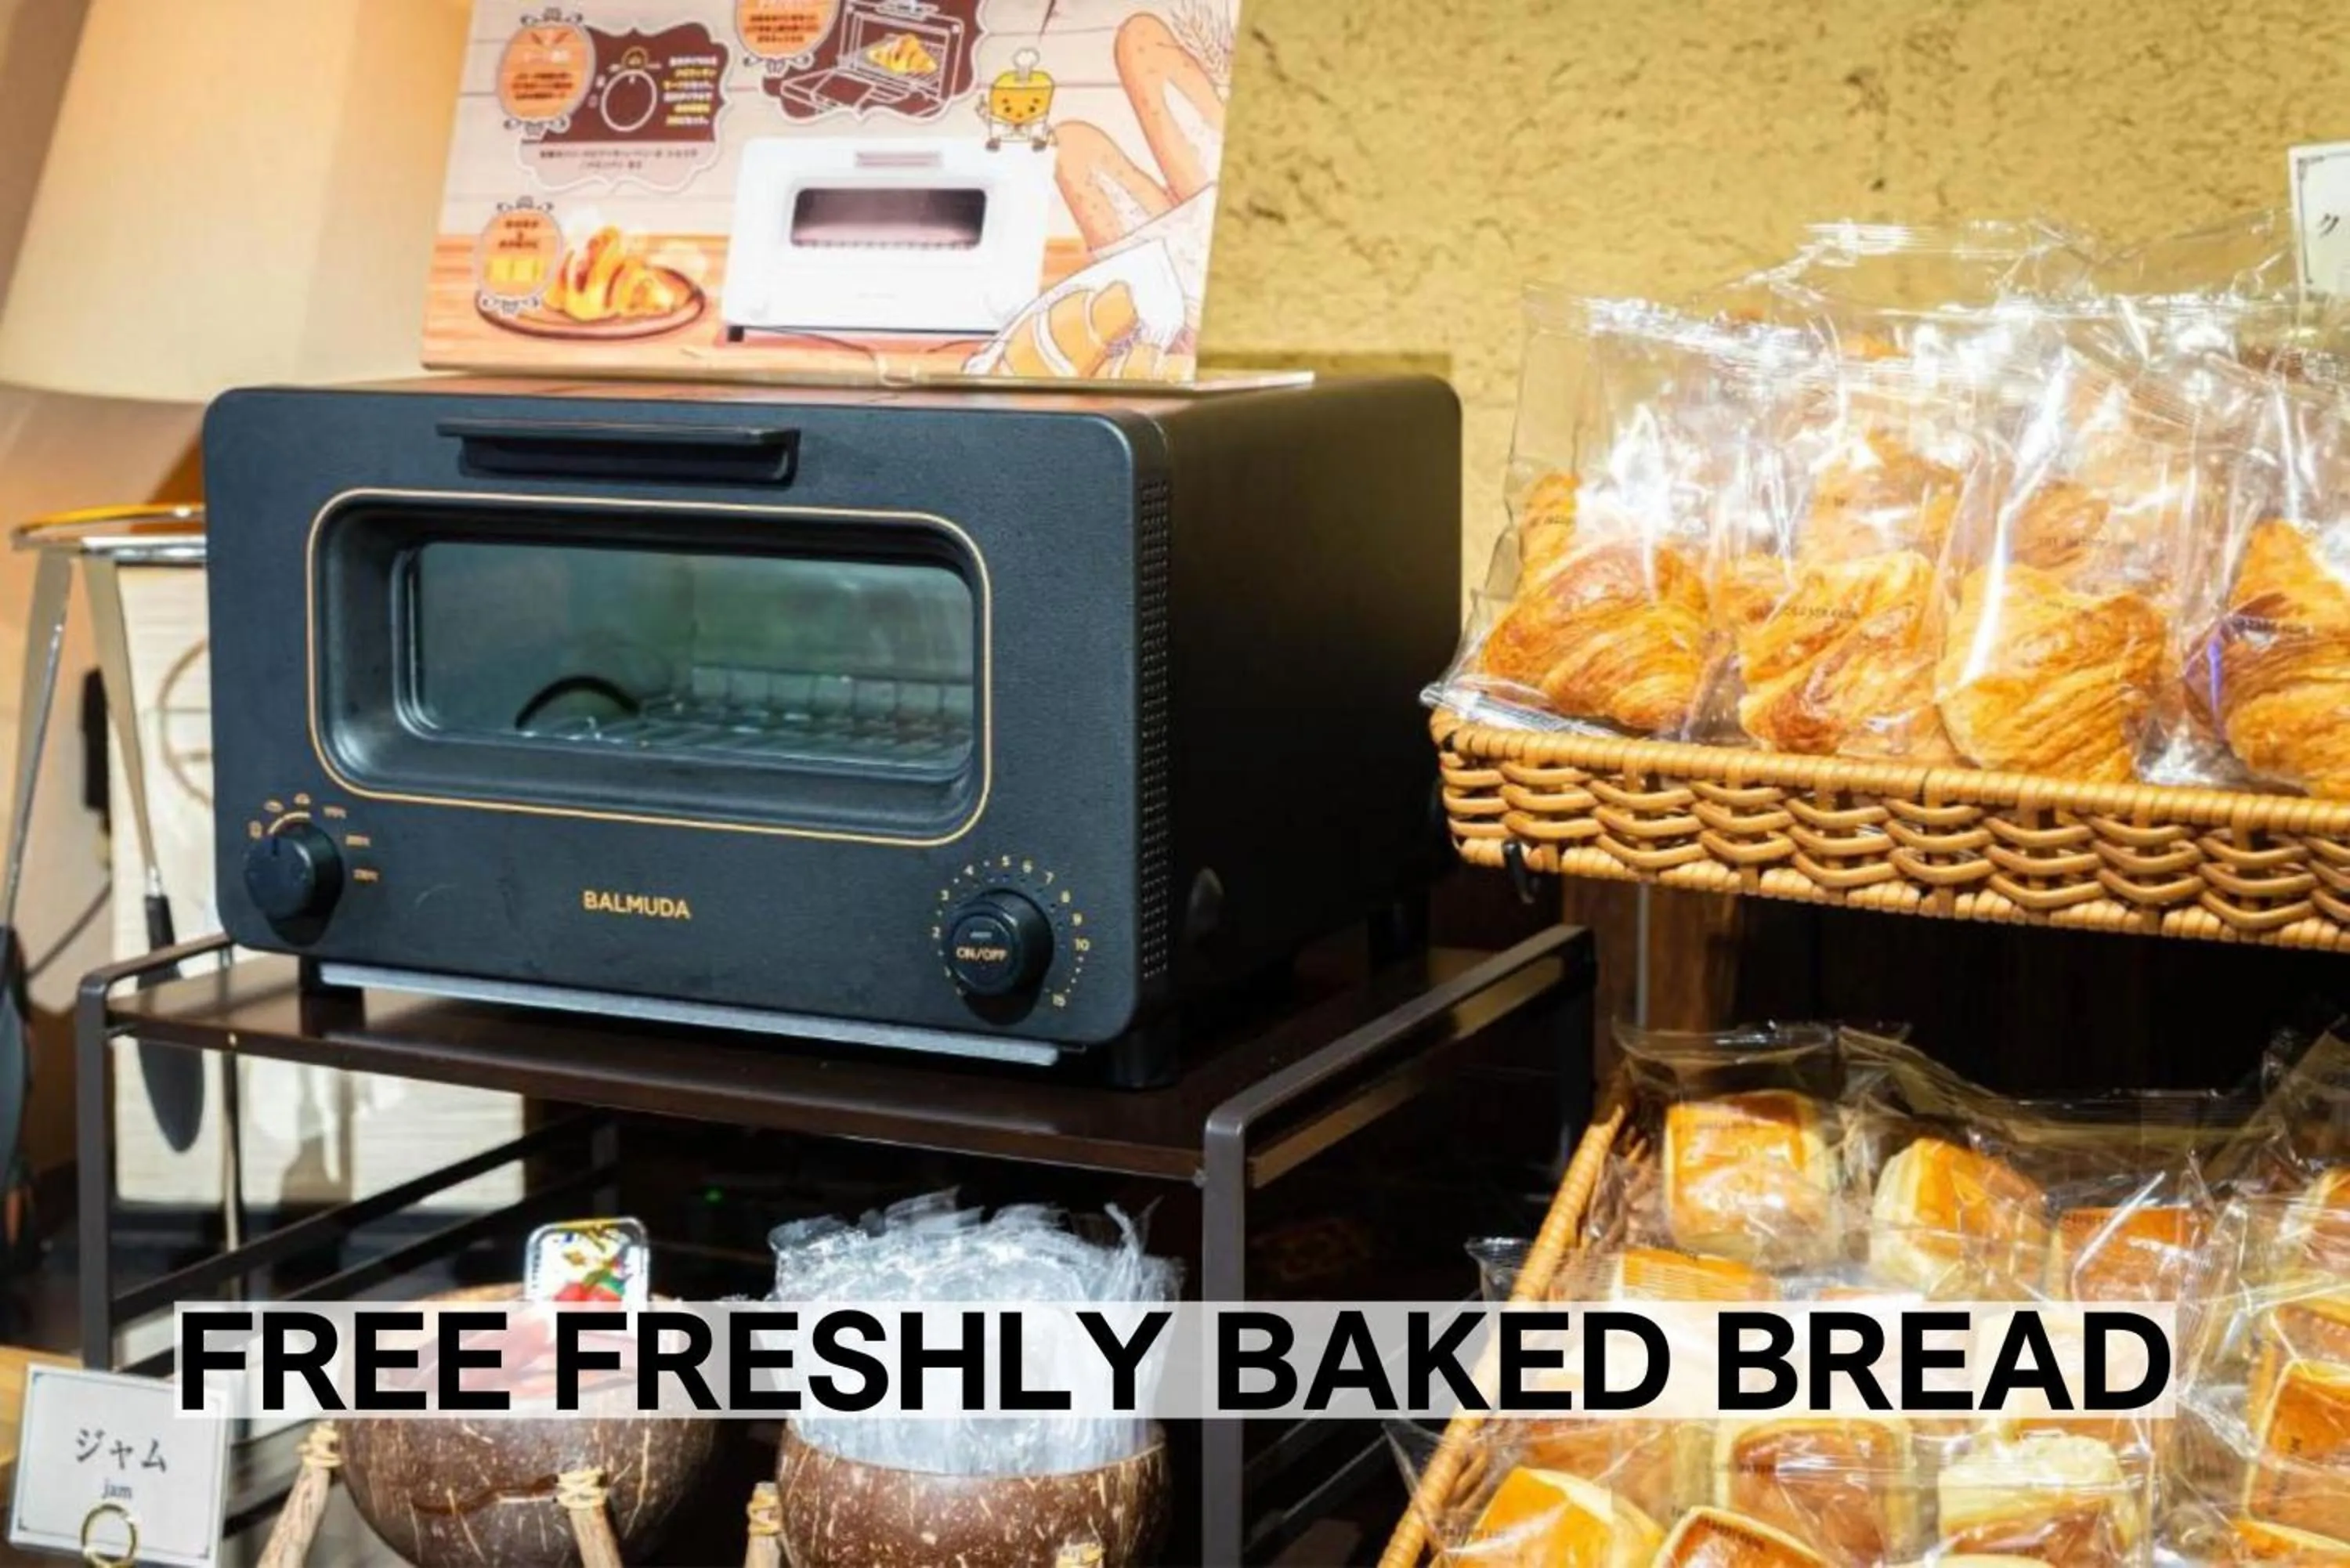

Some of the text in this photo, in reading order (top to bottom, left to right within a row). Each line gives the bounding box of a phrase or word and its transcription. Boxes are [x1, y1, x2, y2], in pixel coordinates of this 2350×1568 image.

[583, 889, 692, 921] BALMUDA
[931, 926, 941, 939] 2
[963, 863, 975, 876] 4
[1045, 871, 1054, 884] 7
[1074, 938, 1090, 952] 10
[956, 946, 1007, 961] ON/OFF
[76, 1429, 167, 1473] ジャム
[102, 1479, 132, 1500] jam
